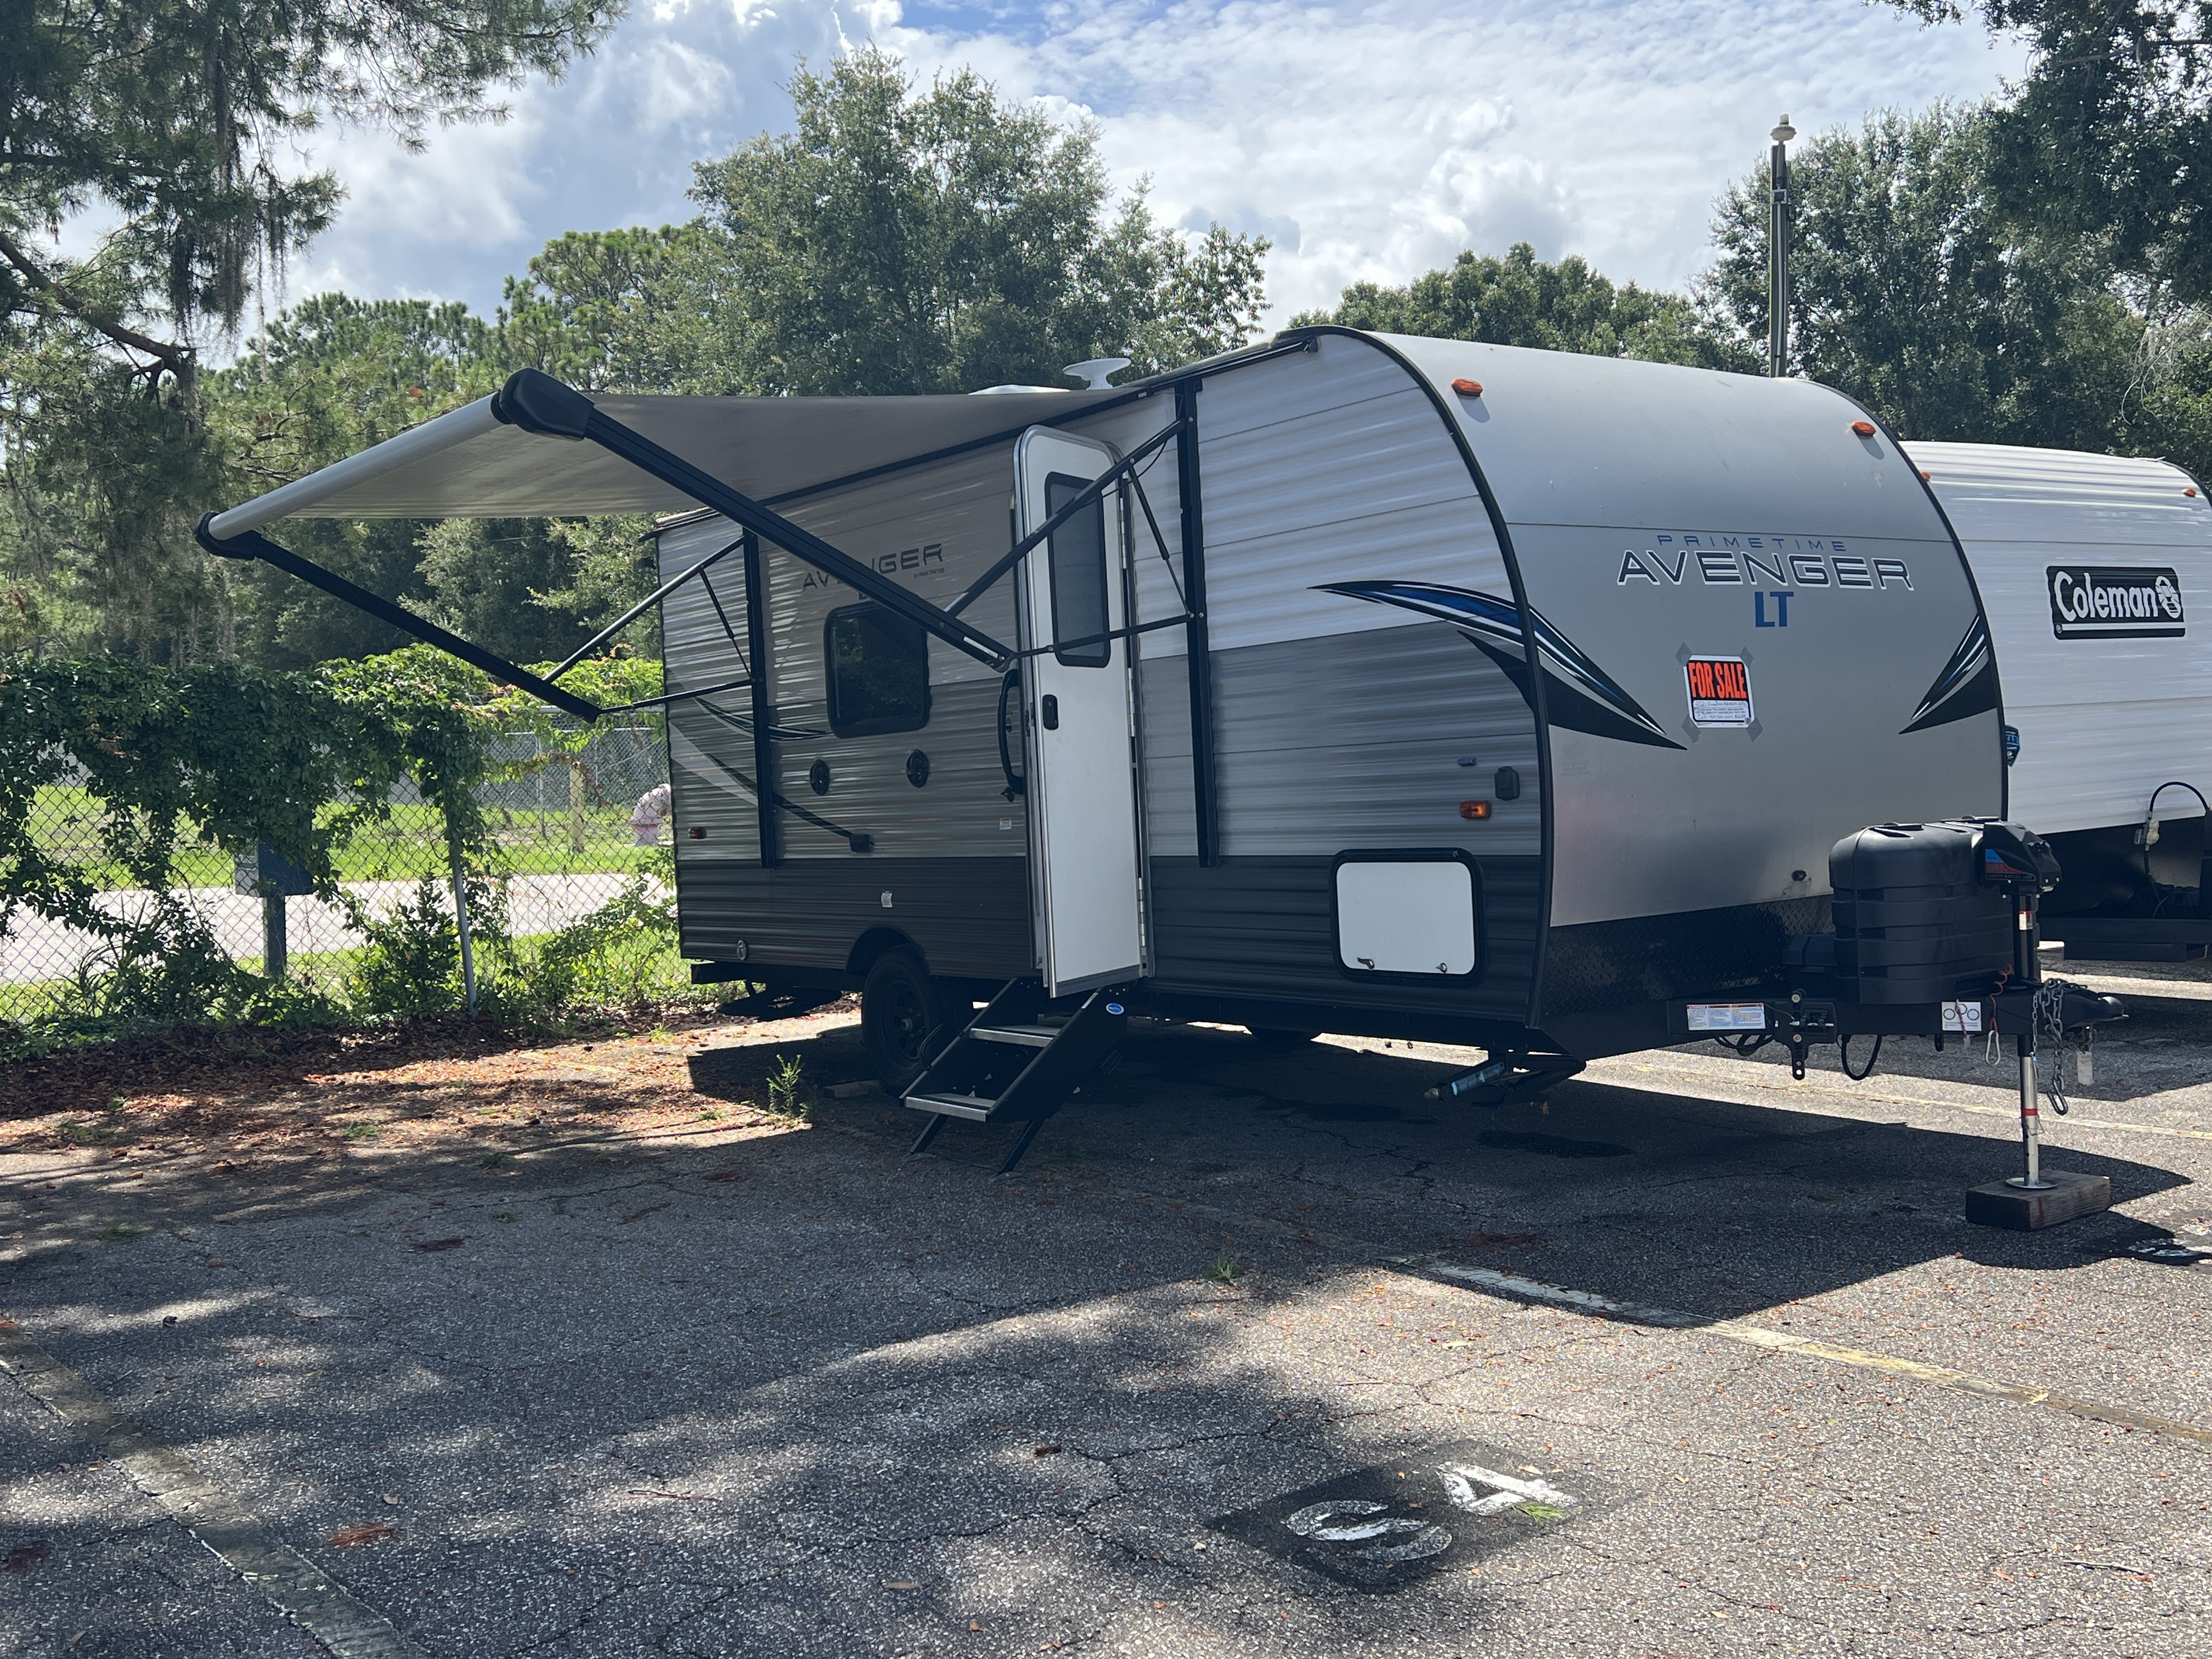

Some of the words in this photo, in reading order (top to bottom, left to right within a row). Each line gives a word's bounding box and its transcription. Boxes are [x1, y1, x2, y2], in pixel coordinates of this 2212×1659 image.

[1657, 535, 1847, 551] PRIMETIME
[803, 543, 943, 591] AVGER
[1617, 550, 1914, 591] AVENGER
[1754, 591, 1794, 627] LT
[2054, 571, 2158, 622] Coleman
[1689, 662, 1716, 698] FOR
[1714, 662, 1747, 699] SALE
